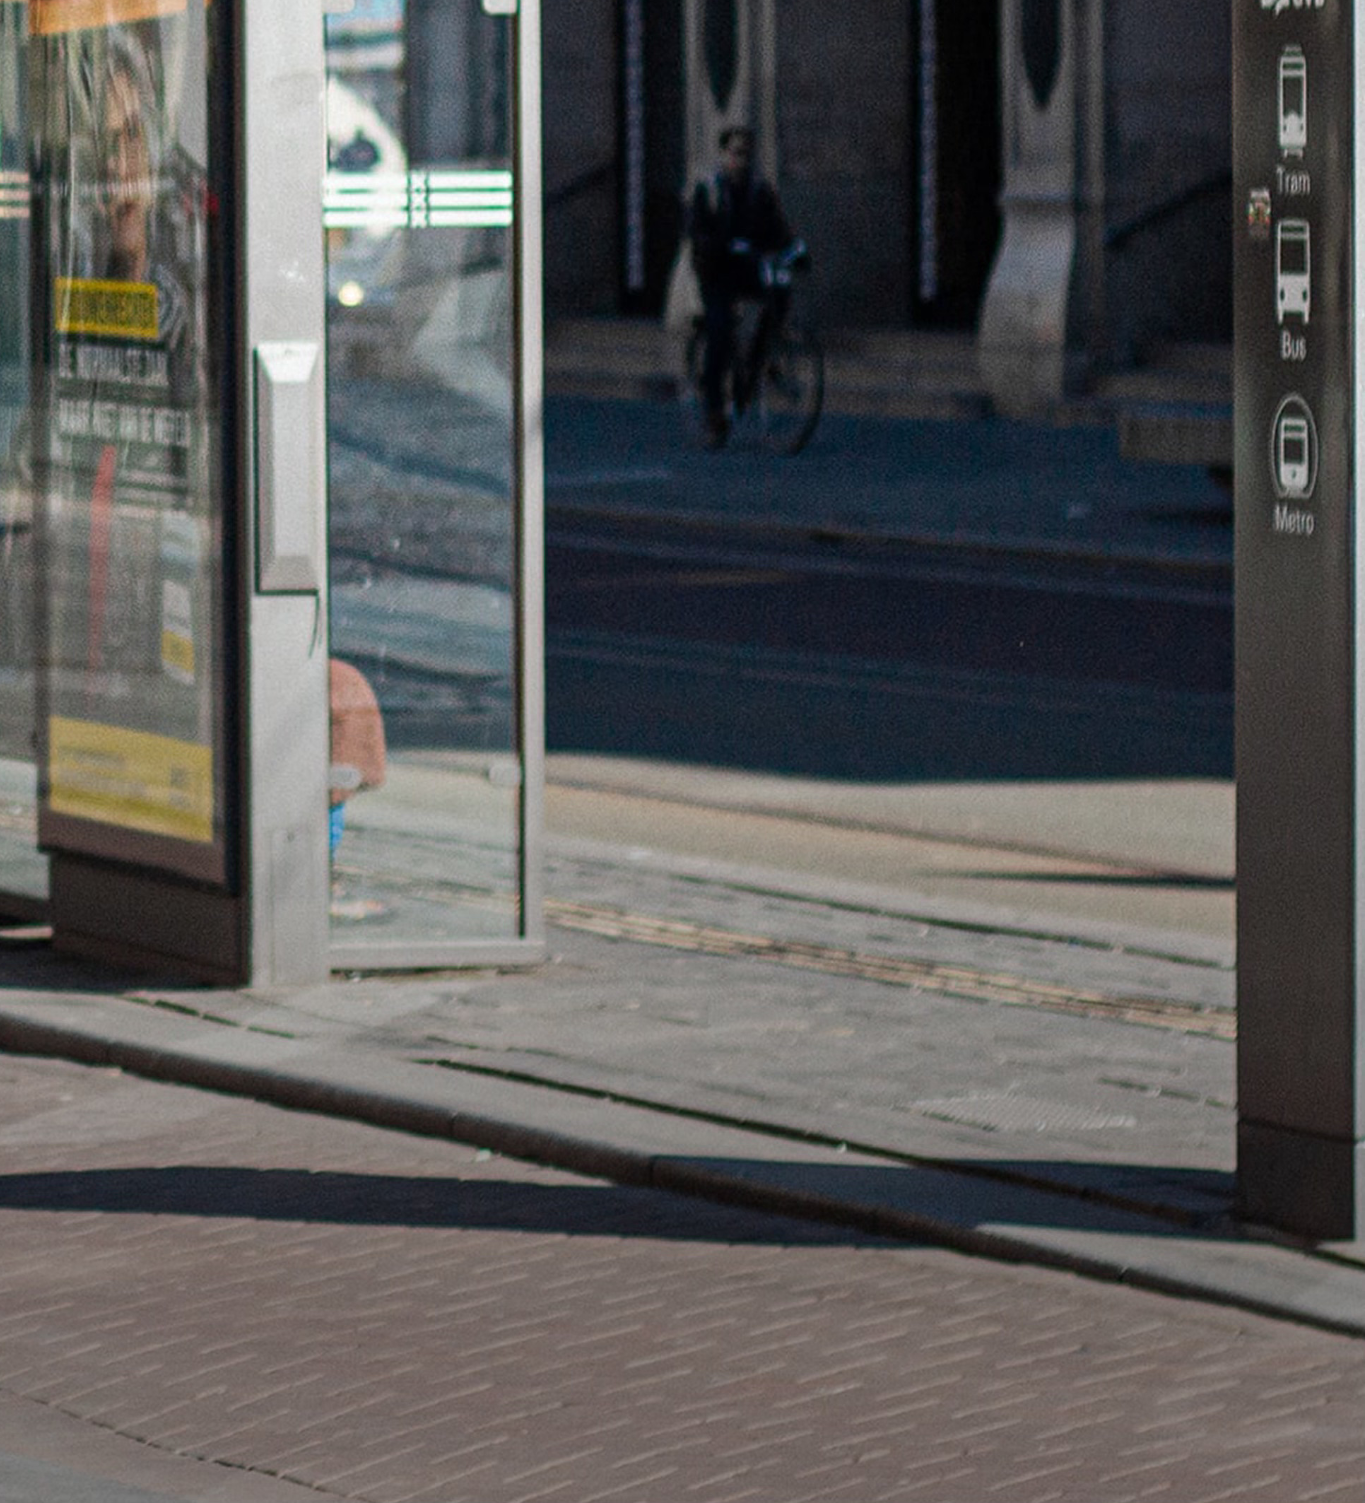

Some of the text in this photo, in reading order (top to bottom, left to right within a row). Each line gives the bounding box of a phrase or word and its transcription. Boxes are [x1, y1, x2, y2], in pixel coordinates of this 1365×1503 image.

[1276, 164, 1311, 194] Tram
[1281, 329, 1307, 360] Bus
[1274, 504, 1315, 534] Metro
